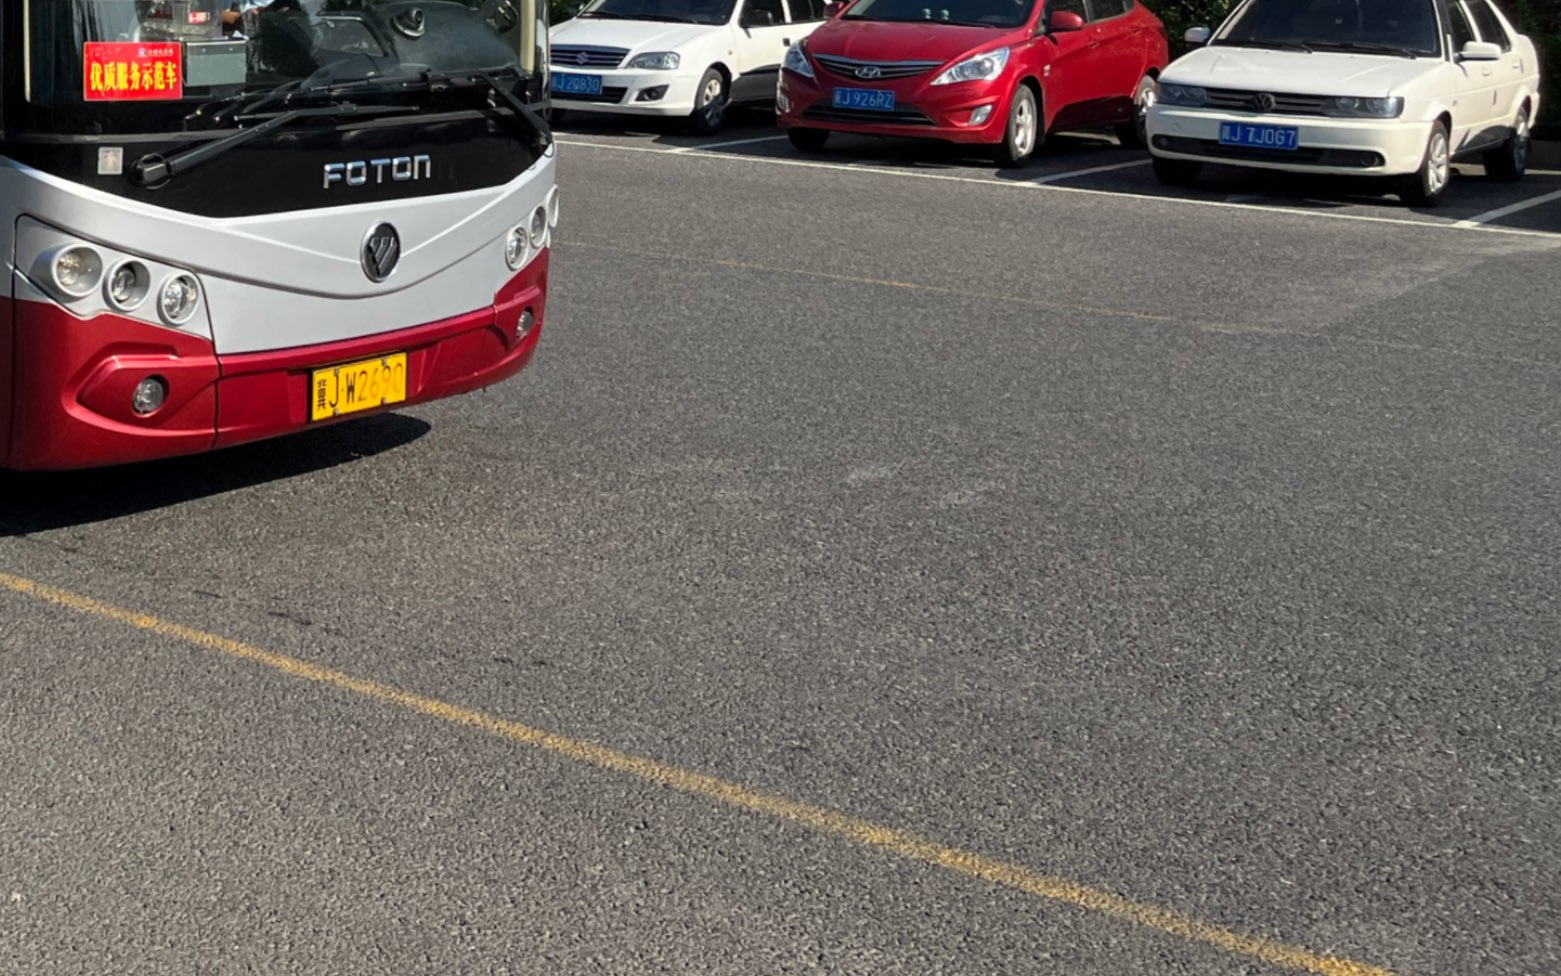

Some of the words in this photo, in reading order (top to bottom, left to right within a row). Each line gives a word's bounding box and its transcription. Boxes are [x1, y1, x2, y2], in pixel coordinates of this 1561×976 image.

[91, 61, 176, 91] 优质服务示范车
[324, 155, 431, 189] FOTON
